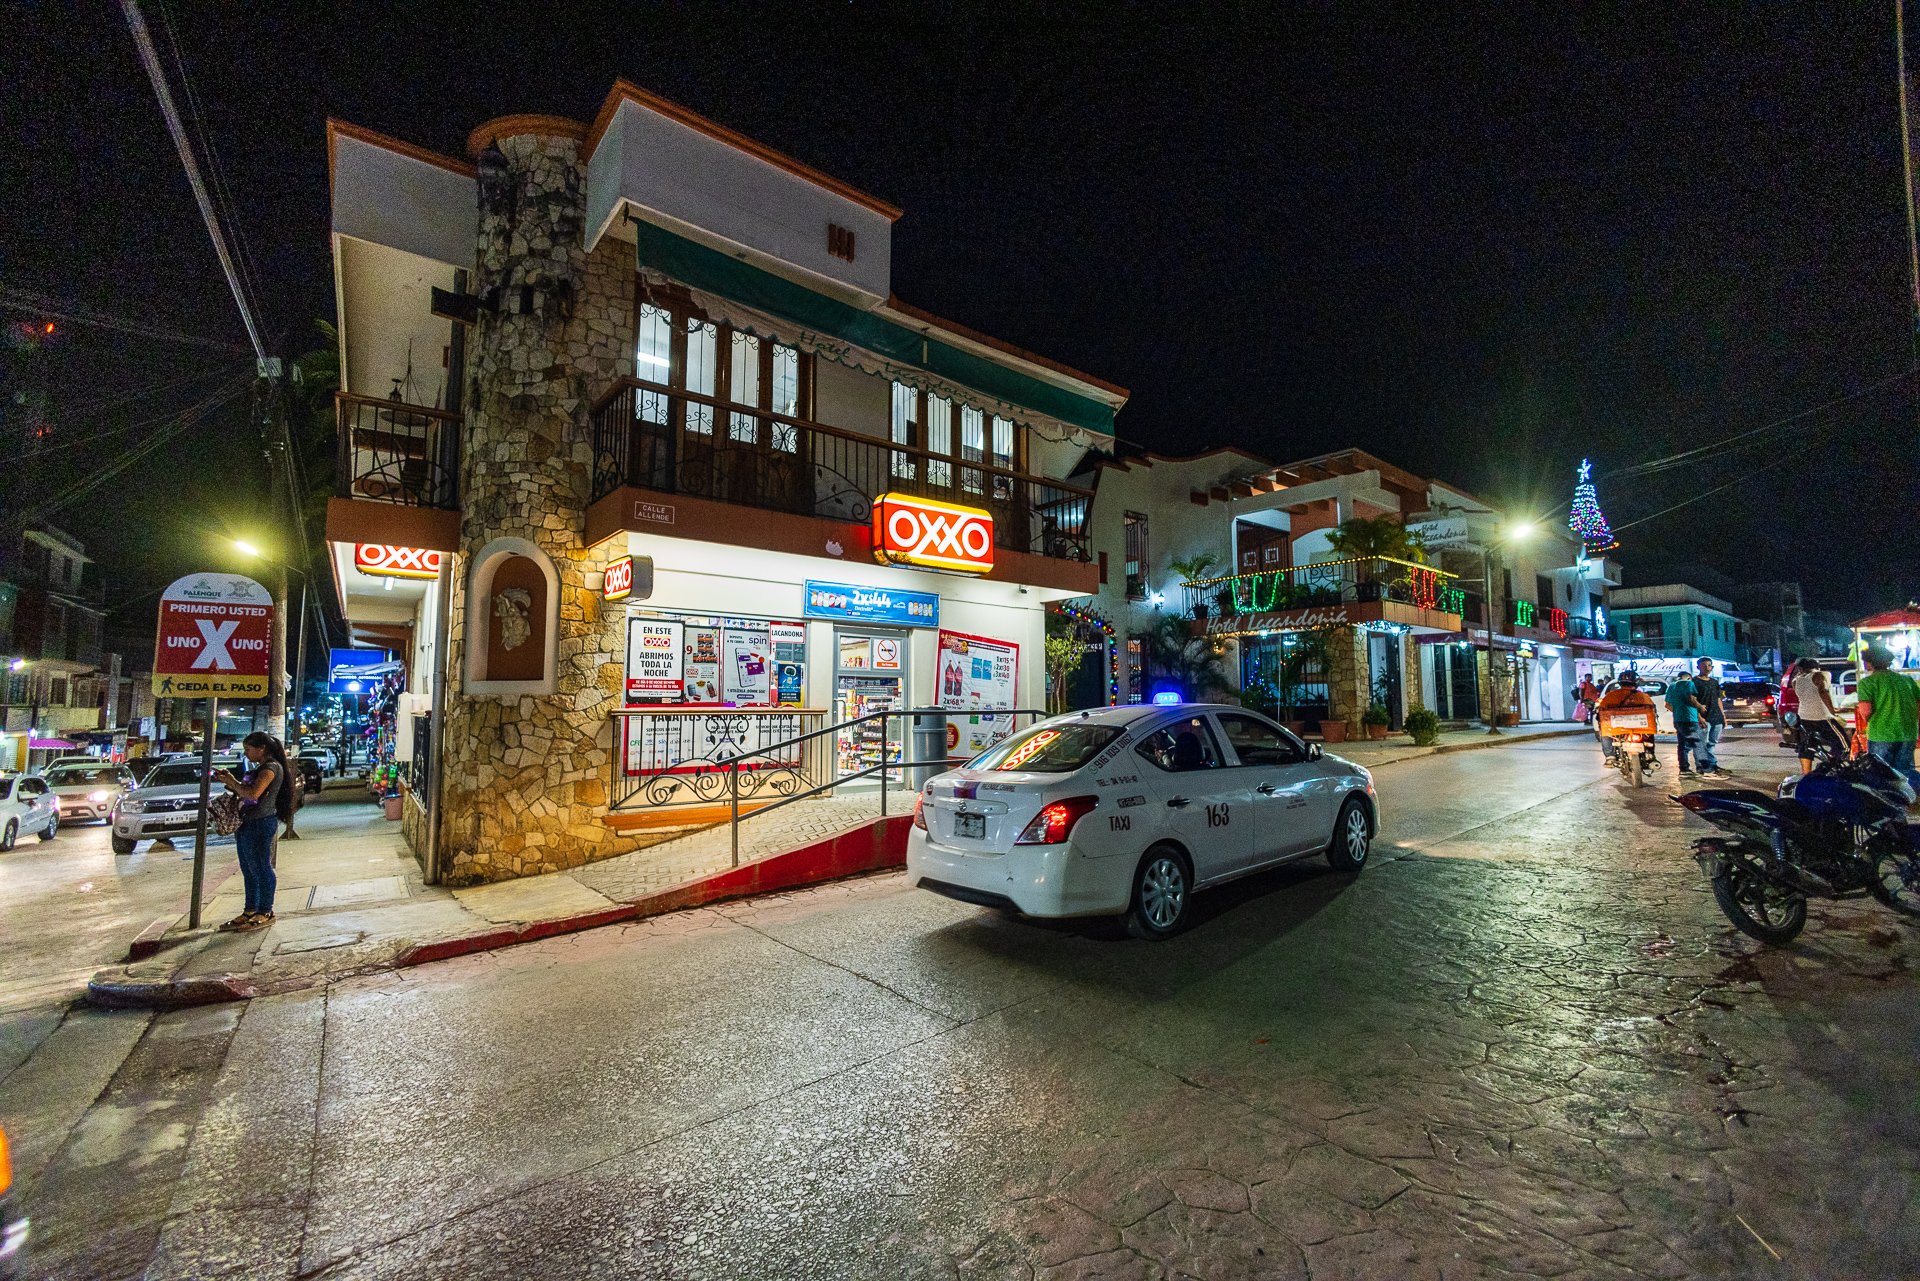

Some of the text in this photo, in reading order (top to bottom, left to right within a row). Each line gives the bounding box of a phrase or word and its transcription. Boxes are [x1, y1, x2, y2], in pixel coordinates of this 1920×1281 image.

[642, 504, 666, 514] CALLE
[638, 512, 670, 522] ALLENDE
[888, 509, 990, 558] OXXO
[359, 543, 439, 571] OXXO
[604, 559, 632, 593] OXXO
[183, 590, 222, 598] PALENQUE
[170, 603, 267, 617] PRIMERO USTED
[1206, 609, 1348, 634] Hotel Lacandonia
[643, 627, 672, 635] EN ESTE
[771, 630, 803, 638] LACANDONA
[167, 636, 201, 648] UNO
[191, 619, 241, 670] X
[232, 639, 264, 650] UNO
[644, 637, 670, 647] OXXO
[748, 635, 767, 645] spin
[639, 652, 674, 660] ABRIMOS
[641, 660, 672, 669] TODA LA
[644, 669, 669, 677] NOCHE
[176, 682, 262, 692] CEDA EL PASO
[1094, 755, 1109, 769] 916
[1106, 746, 1120, 758] 109
[1205, 802, 1230, 828] 163
[1108, 816, 1131, 832] TAXI
